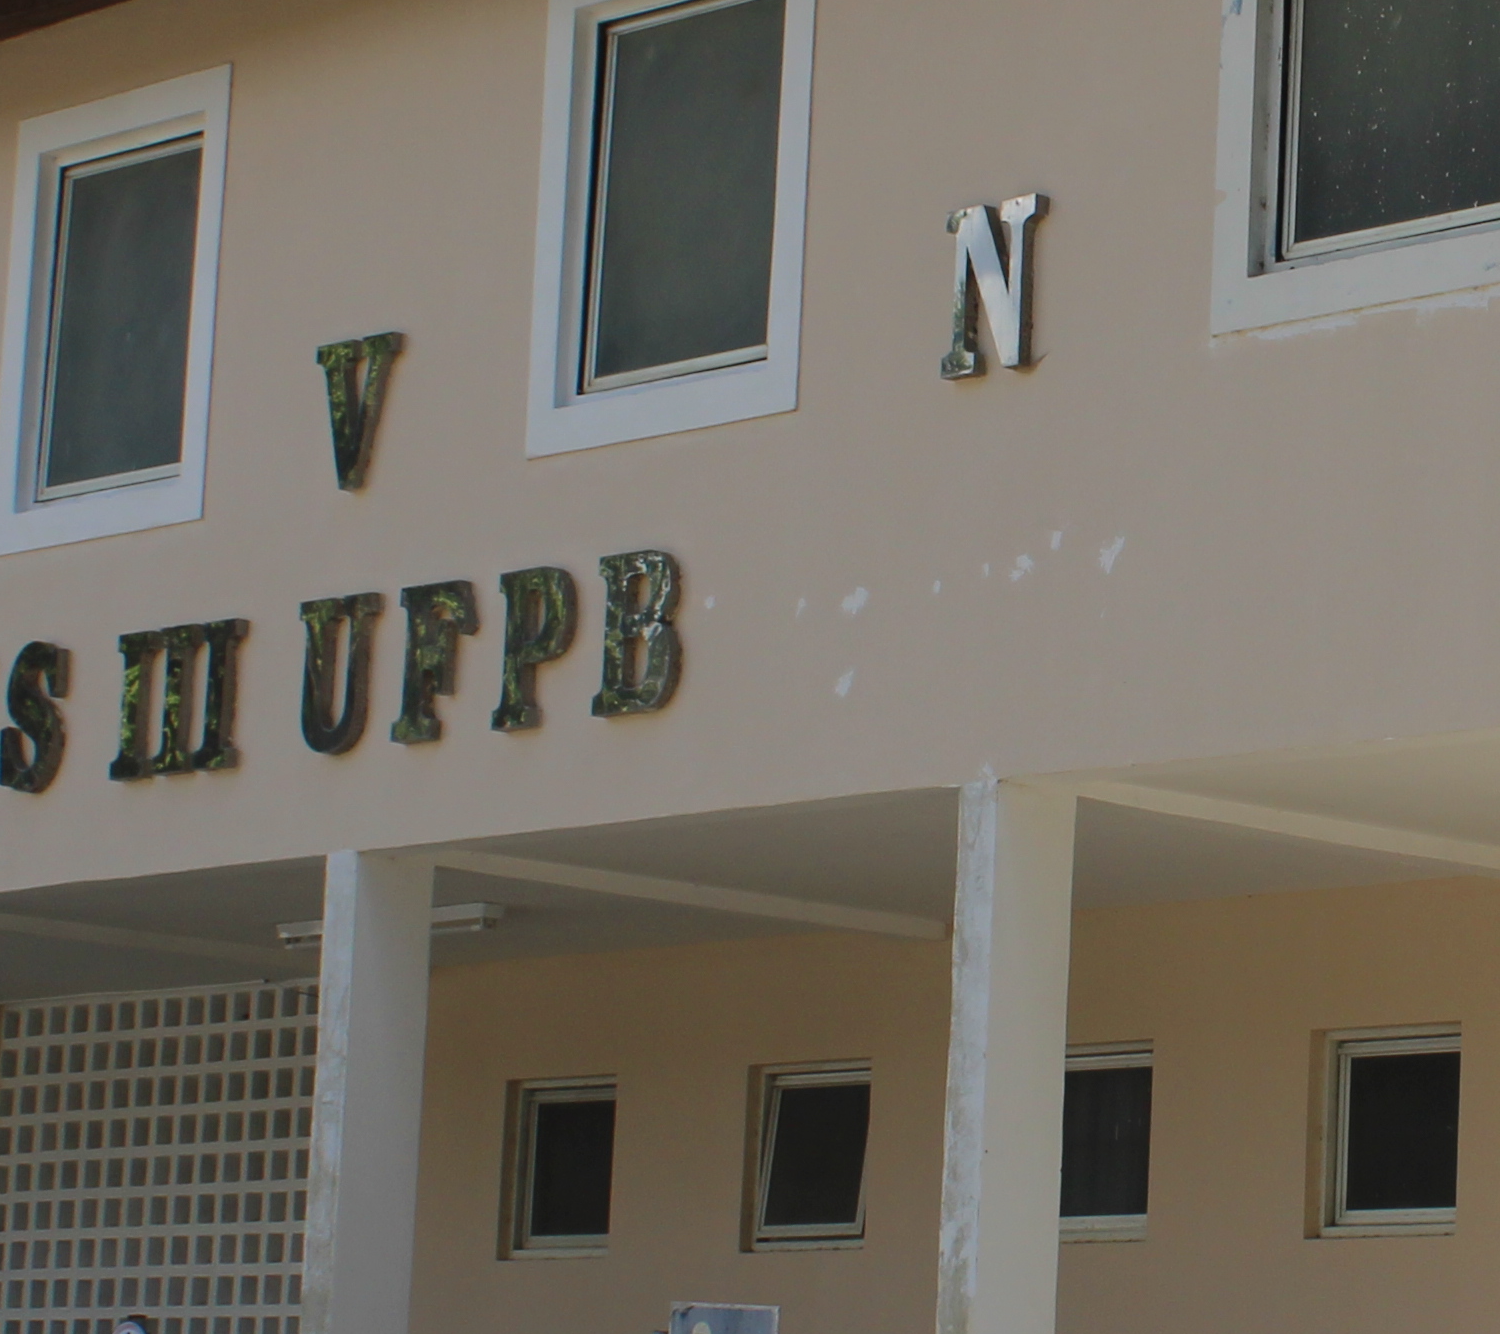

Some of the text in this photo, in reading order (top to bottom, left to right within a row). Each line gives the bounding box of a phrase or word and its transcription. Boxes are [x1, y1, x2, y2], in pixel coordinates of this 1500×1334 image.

[316, 331, 405, 491] V
[940, 192, 1051, 382] N
[109, 617, 249, 782] III
[299, 549, 685, 755] UFPB
